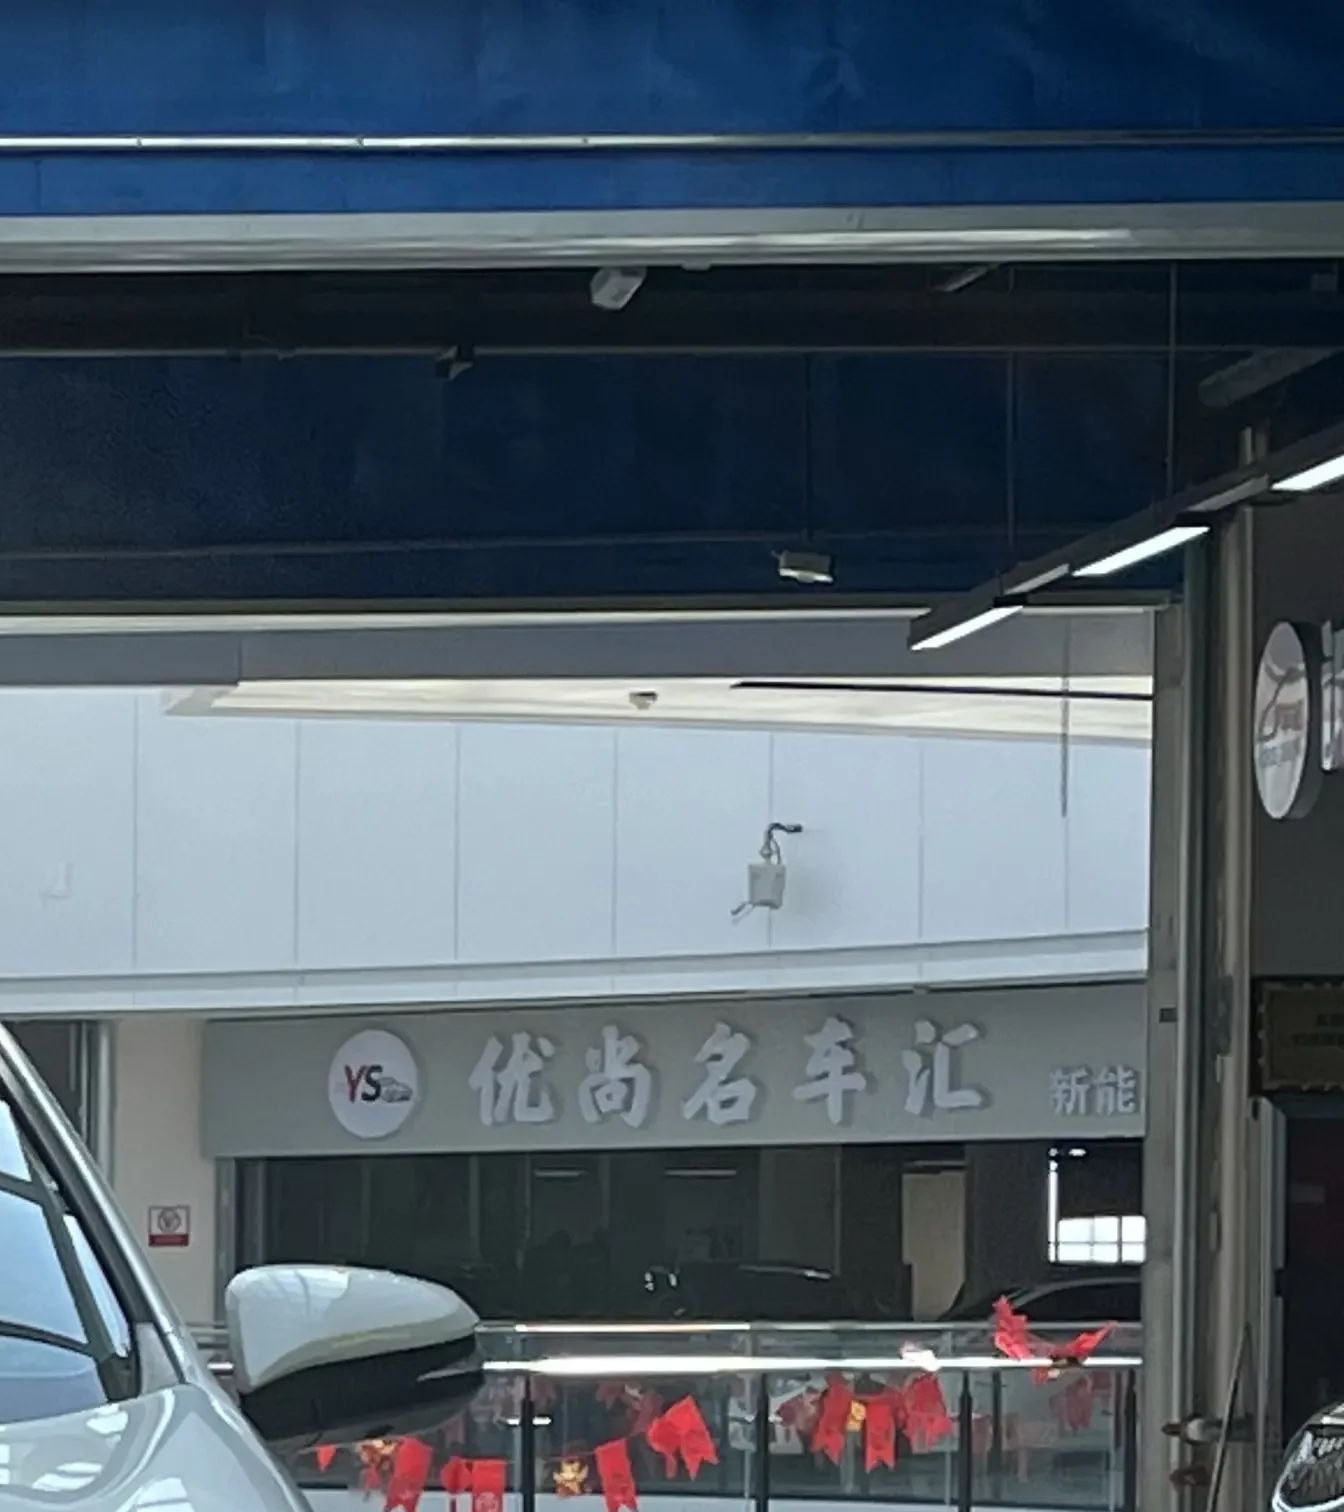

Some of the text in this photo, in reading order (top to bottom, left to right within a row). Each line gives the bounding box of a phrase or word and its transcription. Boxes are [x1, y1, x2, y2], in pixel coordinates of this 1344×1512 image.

[343, 1063, 384, 1104] YS
[468, 1015, 985, 1130] 优尚名车汇
[1049, 1064, 1137, 1116] 新能
